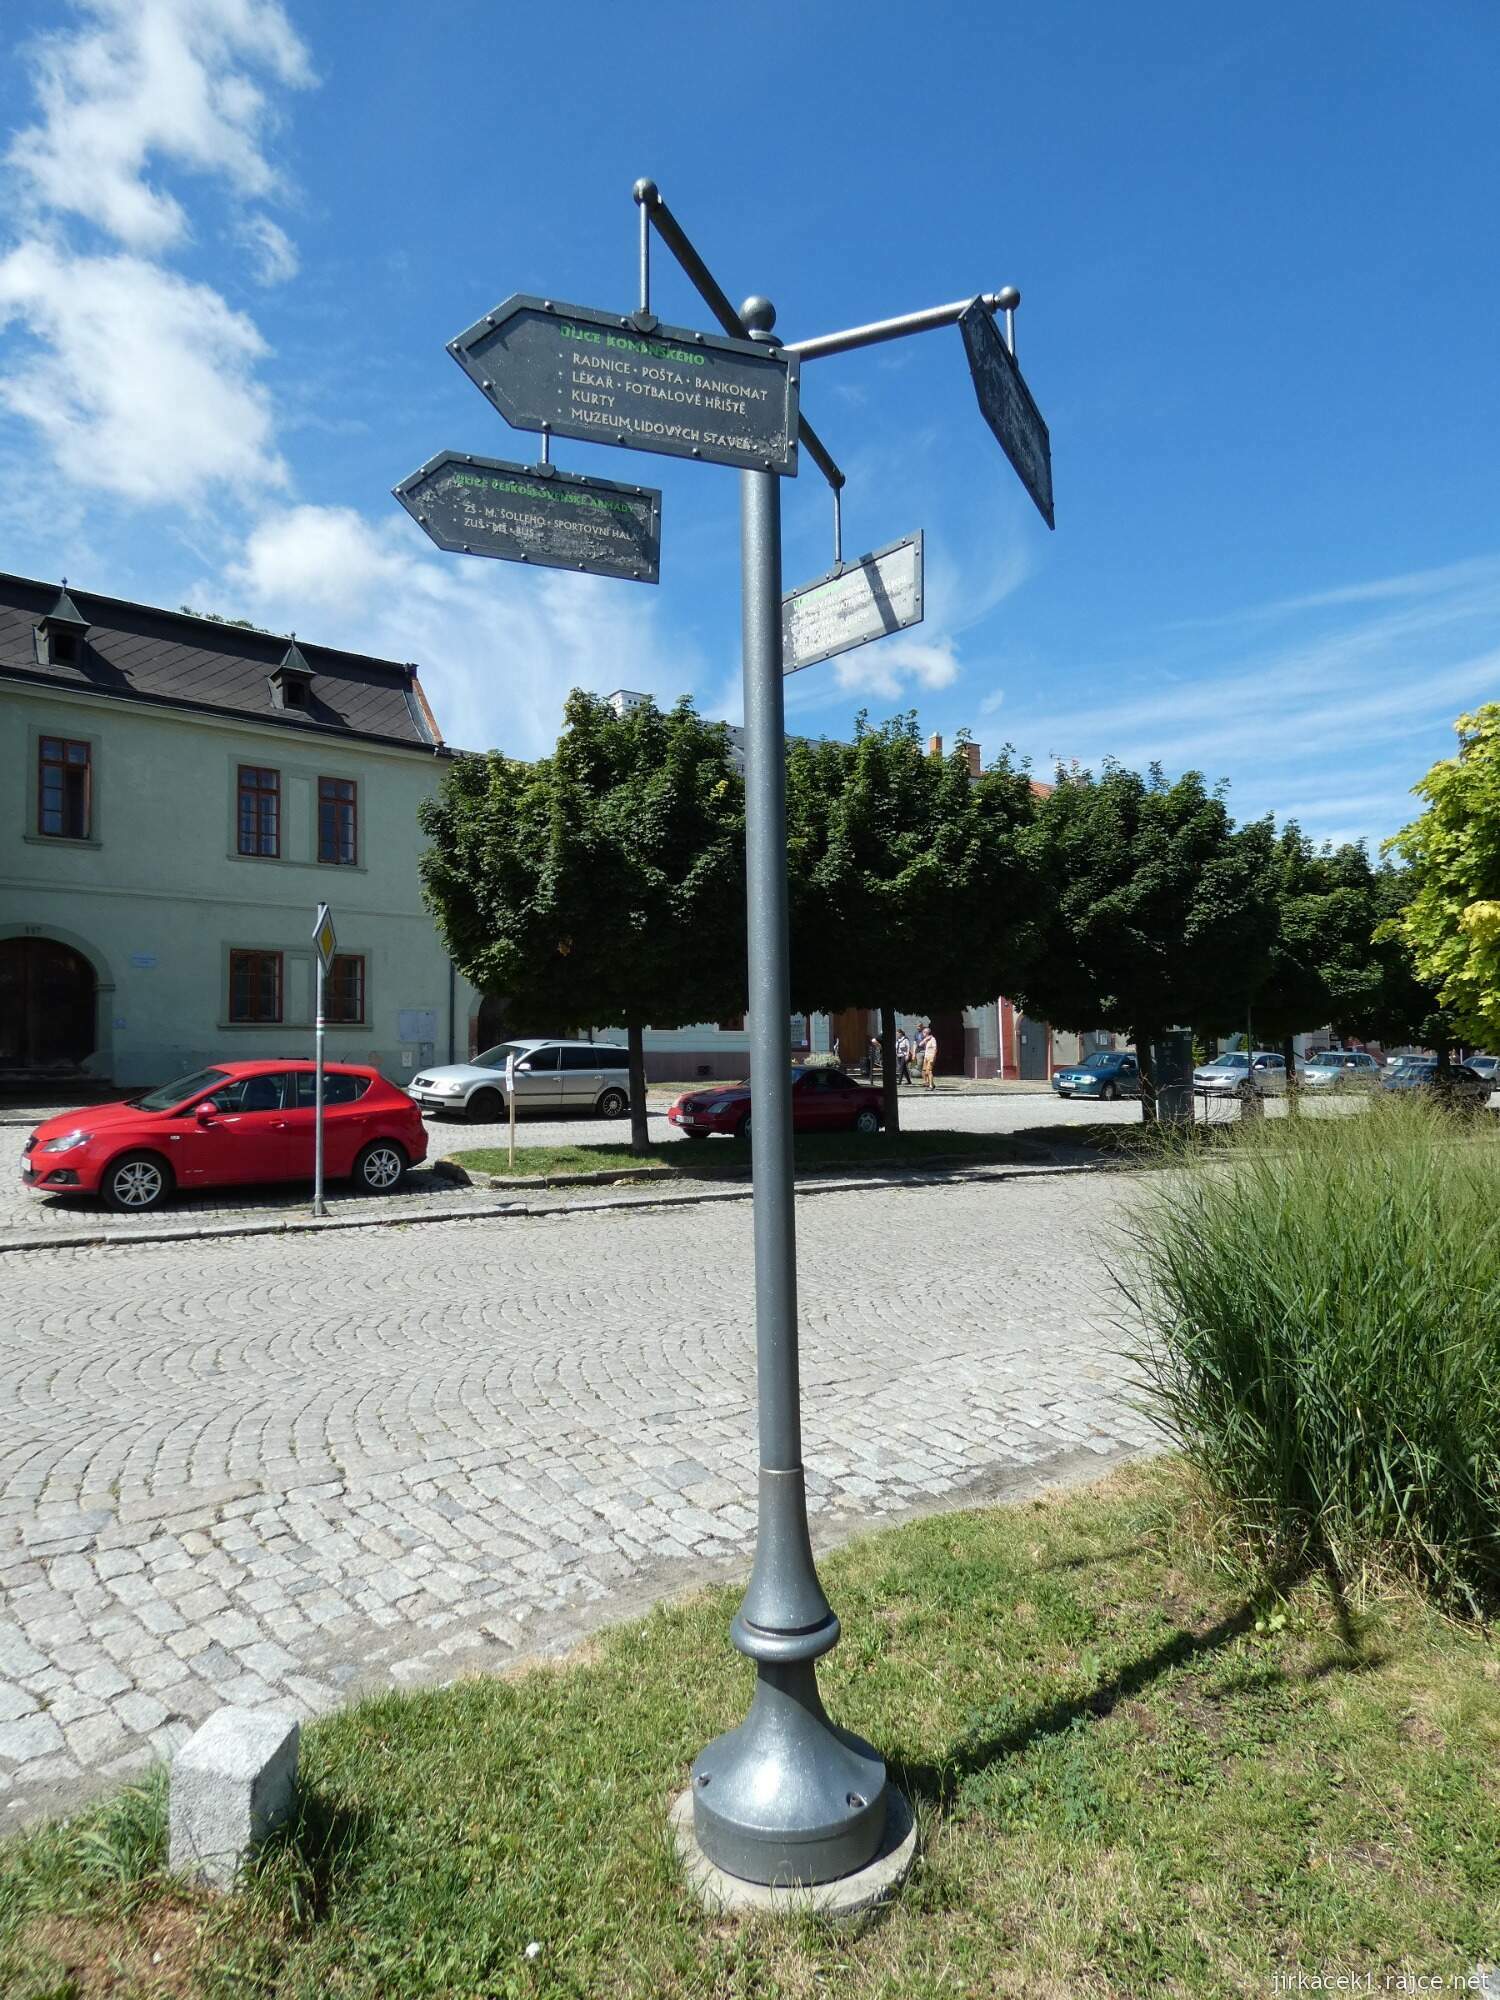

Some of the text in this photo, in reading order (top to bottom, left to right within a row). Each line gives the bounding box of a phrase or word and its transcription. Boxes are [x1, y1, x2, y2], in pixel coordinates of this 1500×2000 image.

[572, 370, 746, 415] LÉKAŘ FOTBALOVÉ HŘIŠTĚ
[573, 352, 768, 401] RADNICE POŠTA BANKOMAT
[572, 389, 615, 408] KURTY
[571, 407, 631, 427] MUZEUM
[634, 418, 700, 441] LIDOVÝCH
[553, 519, 610, 537] SPORTOVNÍ
